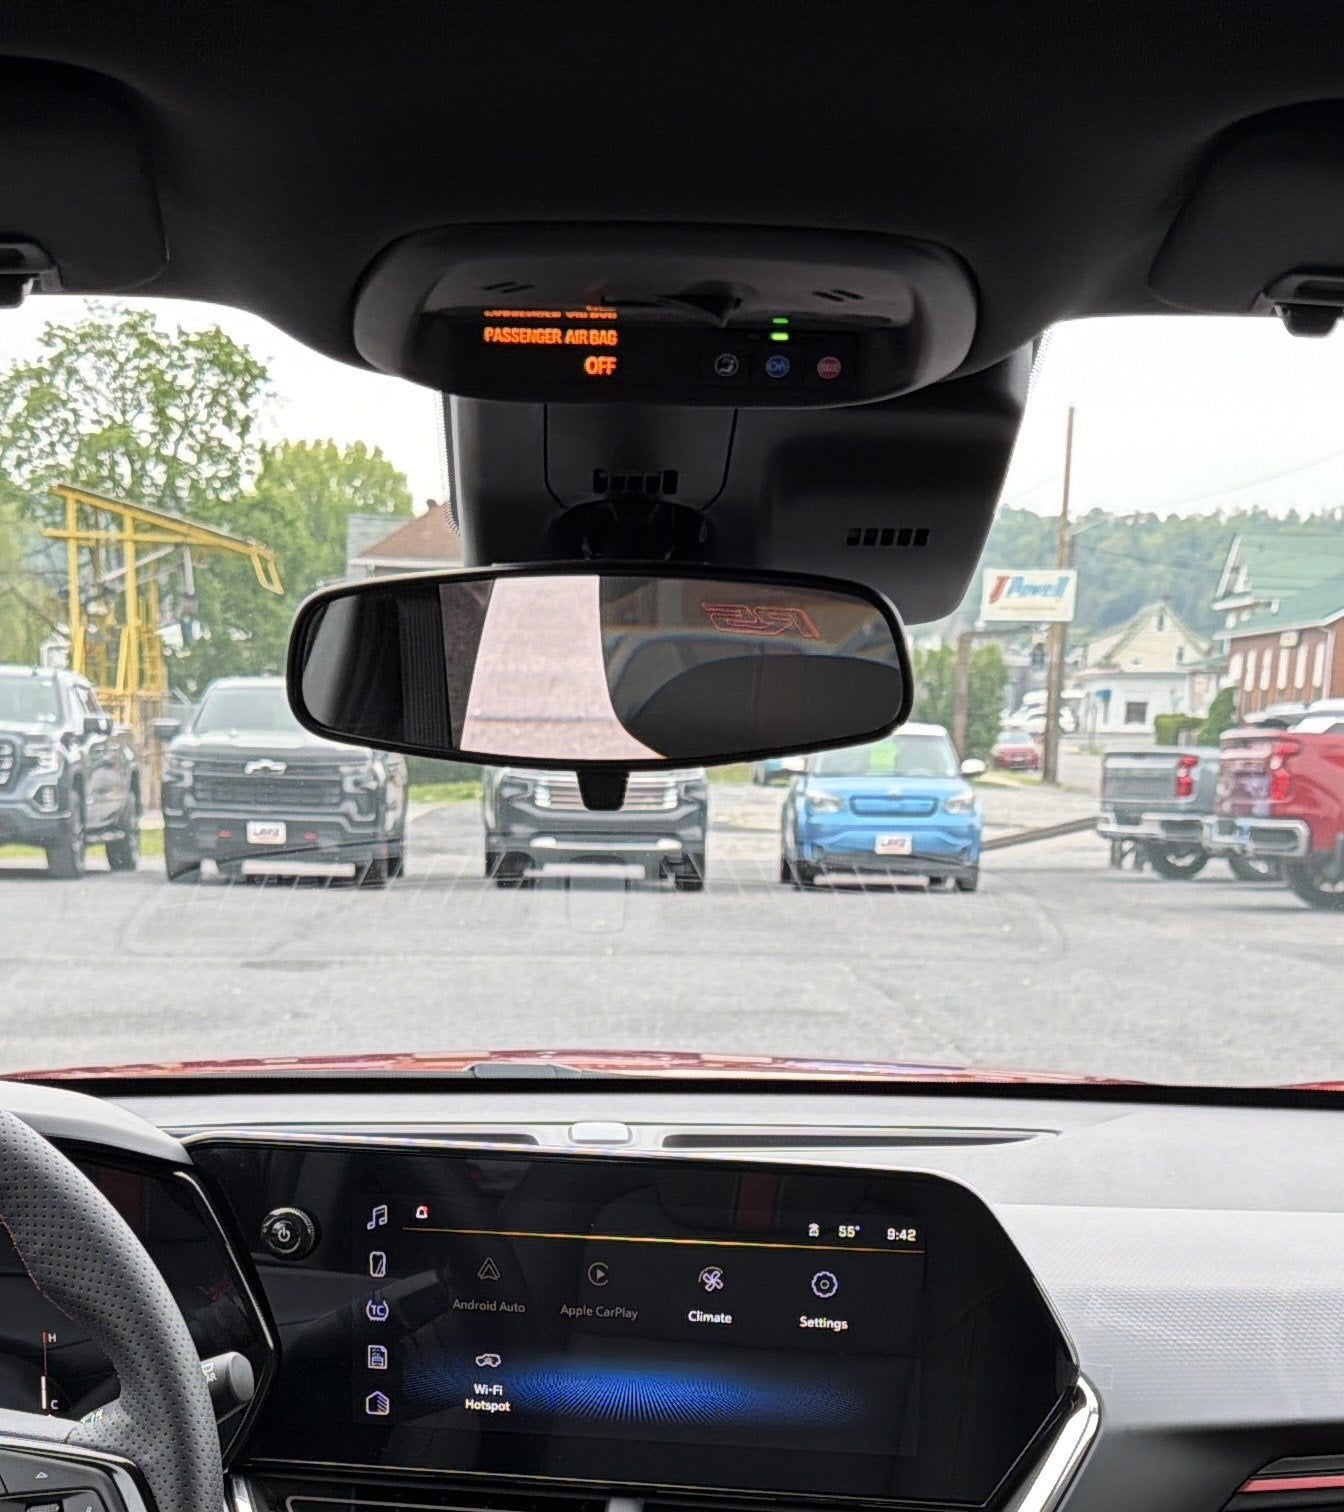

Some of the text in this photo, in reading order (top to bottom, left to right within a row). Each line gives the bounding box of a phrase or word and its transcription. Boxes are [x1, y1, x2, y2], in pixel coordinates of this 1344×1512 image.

[483, 326, 618, 346] PASSENGER AIR BAG
[584, 356, 617, 375] OFF
[887, 1227, 917, 1242] 9:42
[452, 1298, 526, 1314] Android Auto
[560, 1303, 639, 1321] Apple CarPlay
[688, 1310, 733, 1325] Climate
[799, 1315, 849, 1331] Settings
[47, 1333, 57, 1343] H
[473, 1383, 504, 1397] Wi-Fi
[50, 1399, 59, 1410] C
[464, 1397, 511, 1413] Hotspot
